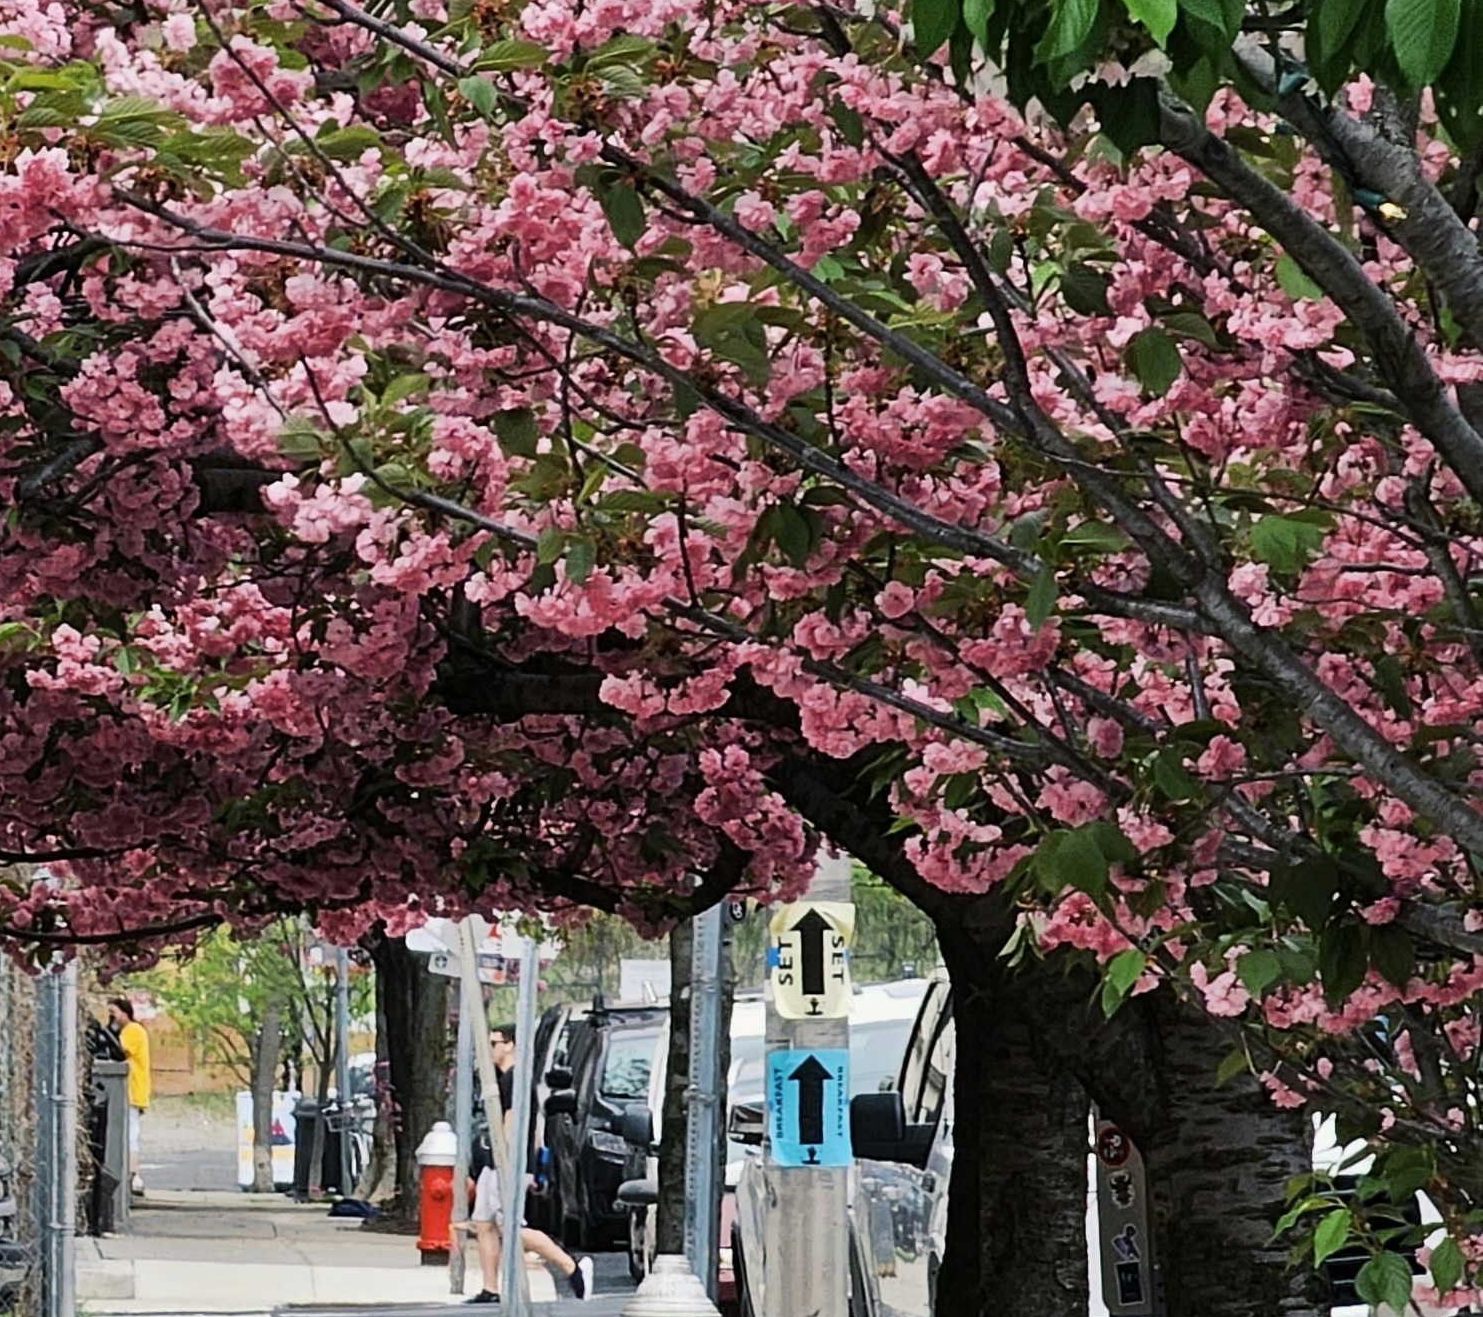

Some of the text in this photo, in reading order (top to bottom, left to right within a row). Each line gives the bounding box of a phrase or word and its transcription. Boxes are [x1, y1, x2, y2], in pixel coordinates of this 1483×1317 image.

[778, 937, 793, 986] SET
[832, 936, 844, 985] SET
[774, 1068, 783, 1139] BREAKFAST
